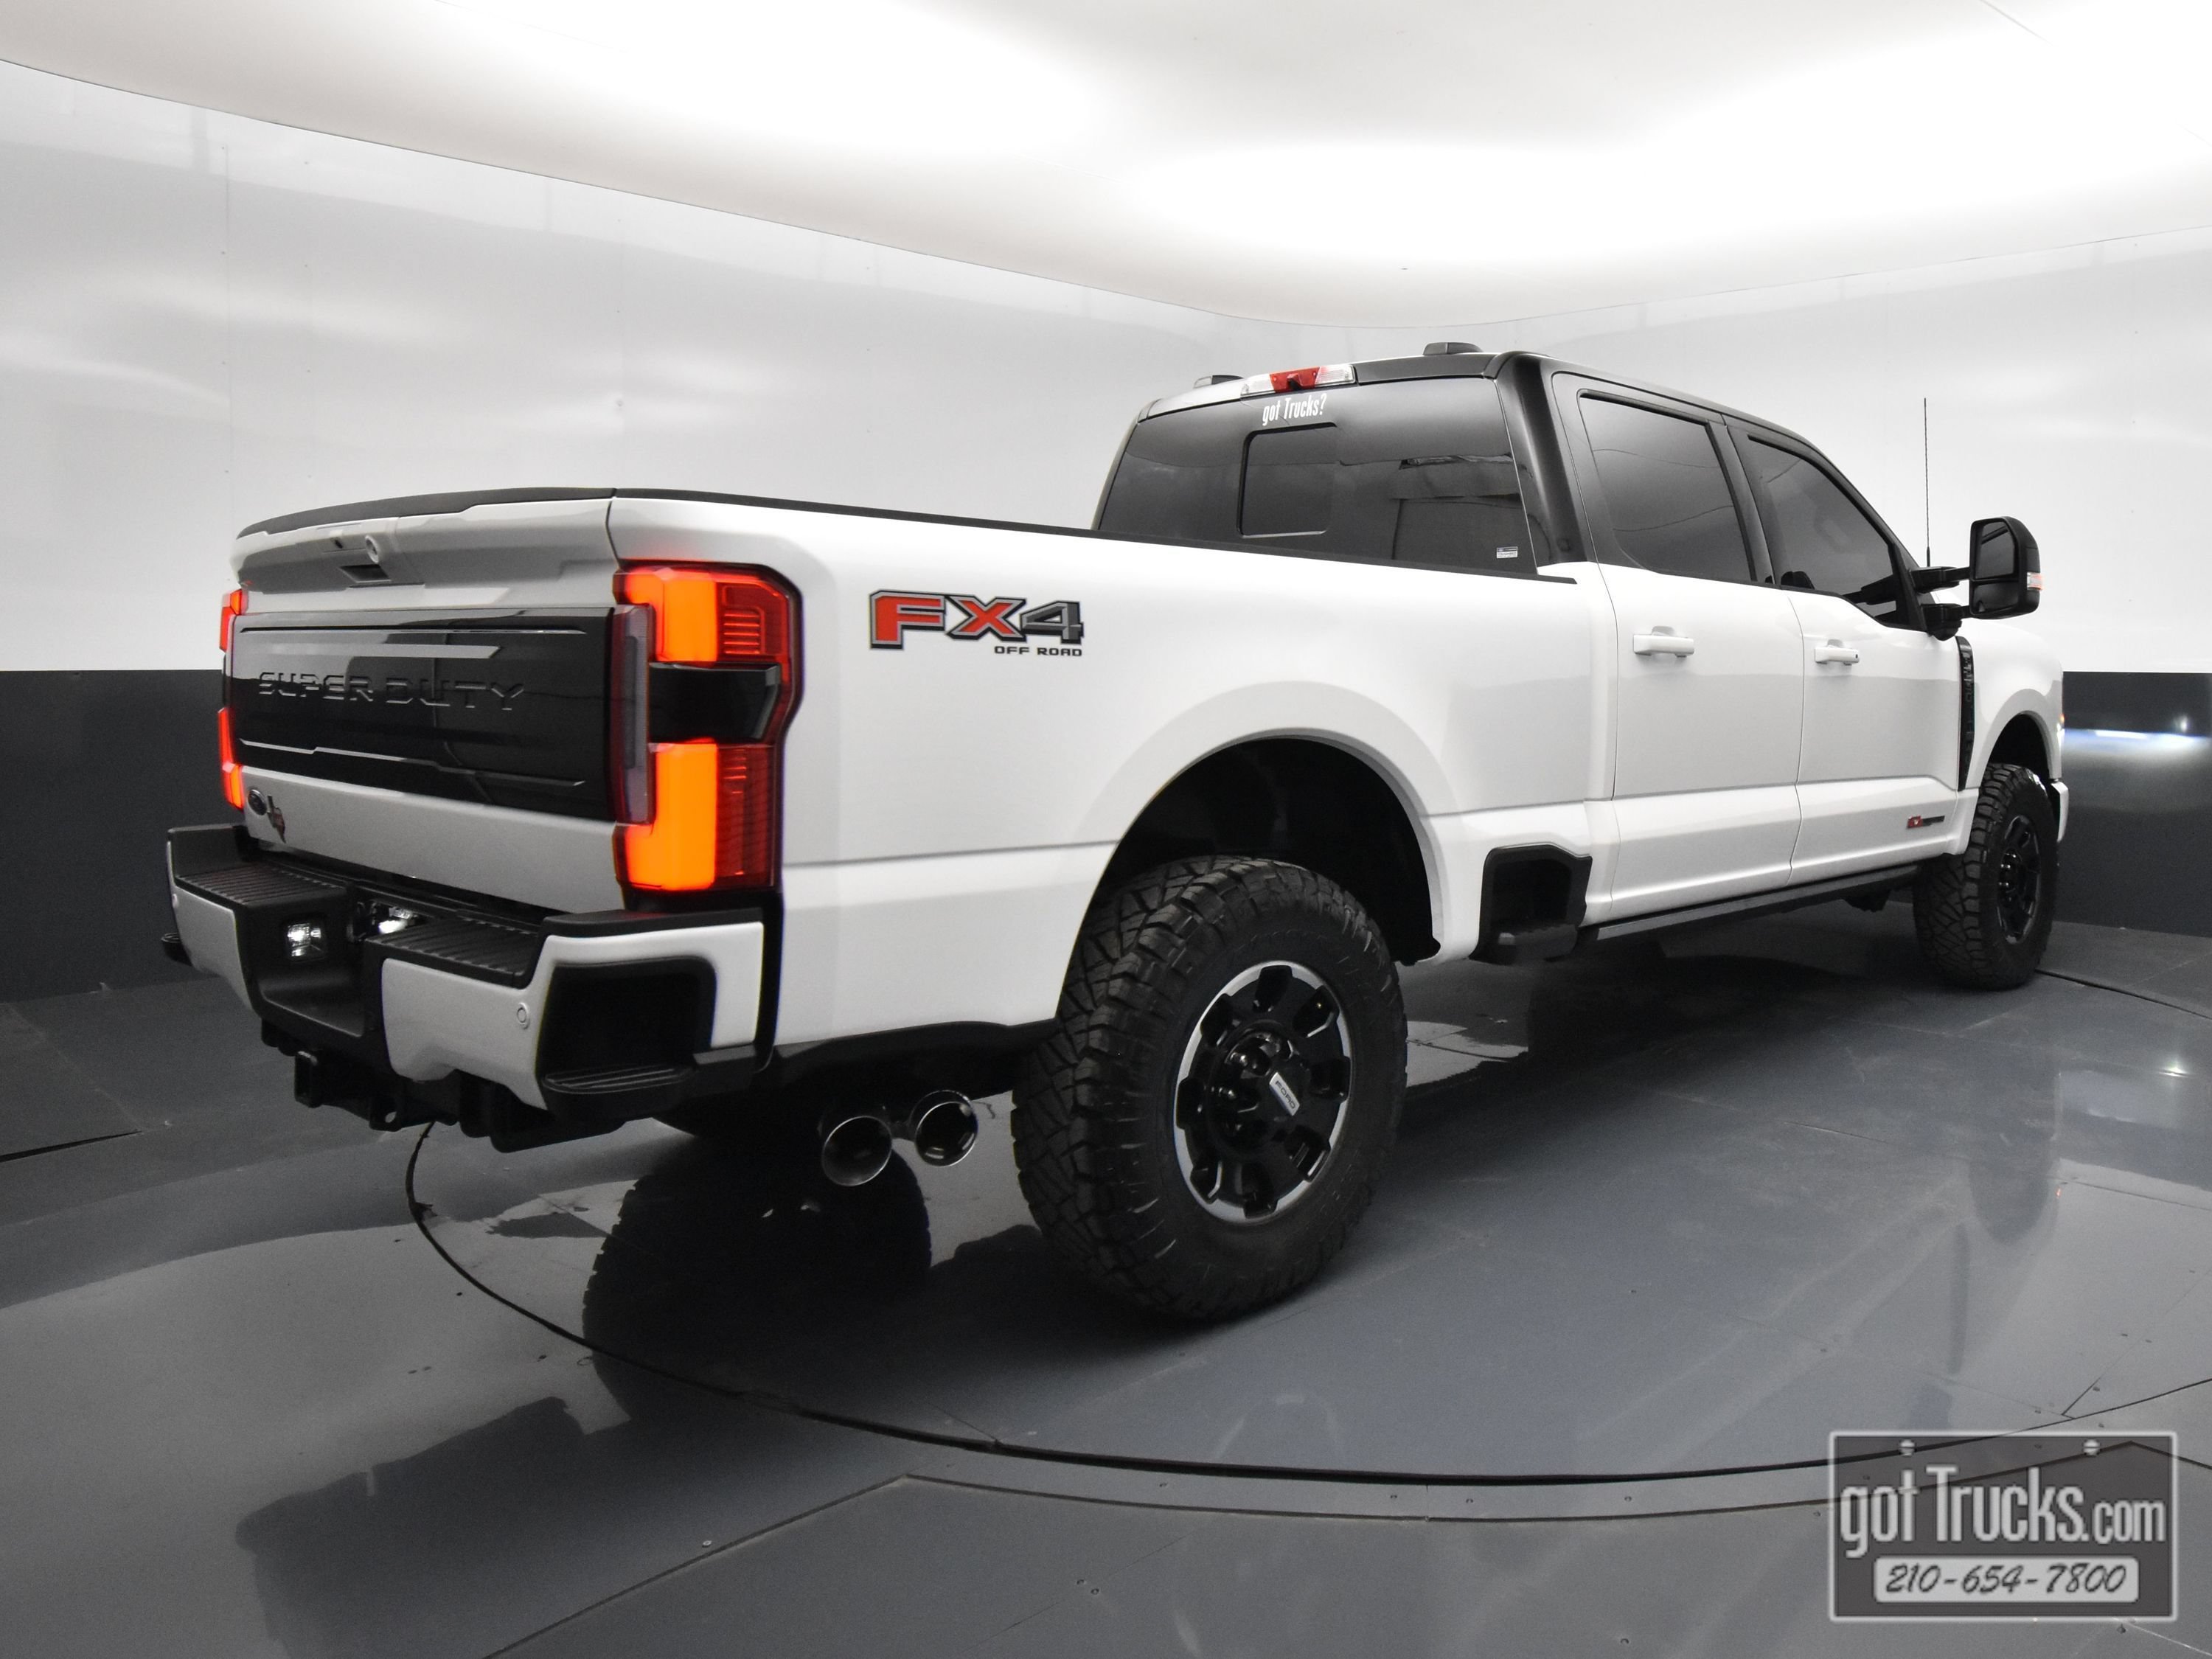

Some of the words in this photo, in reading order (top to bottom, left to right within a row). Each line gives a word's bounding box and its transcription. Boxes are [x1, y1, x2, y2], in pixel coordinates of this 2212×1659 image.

[1262, 400, 1281, 426] got
[1283, 393, 1327, 420] Trucks?
[869, 589, 1085, 650] FX4
[994, 646, 1030, 655] OFF
[1037, 647, 1082, 657] ROAD
[259, 672, 375, 702] SUPER
[386, 676, 525, 711] DUTY
[1275, 1080, 1296, 1110] FORD
